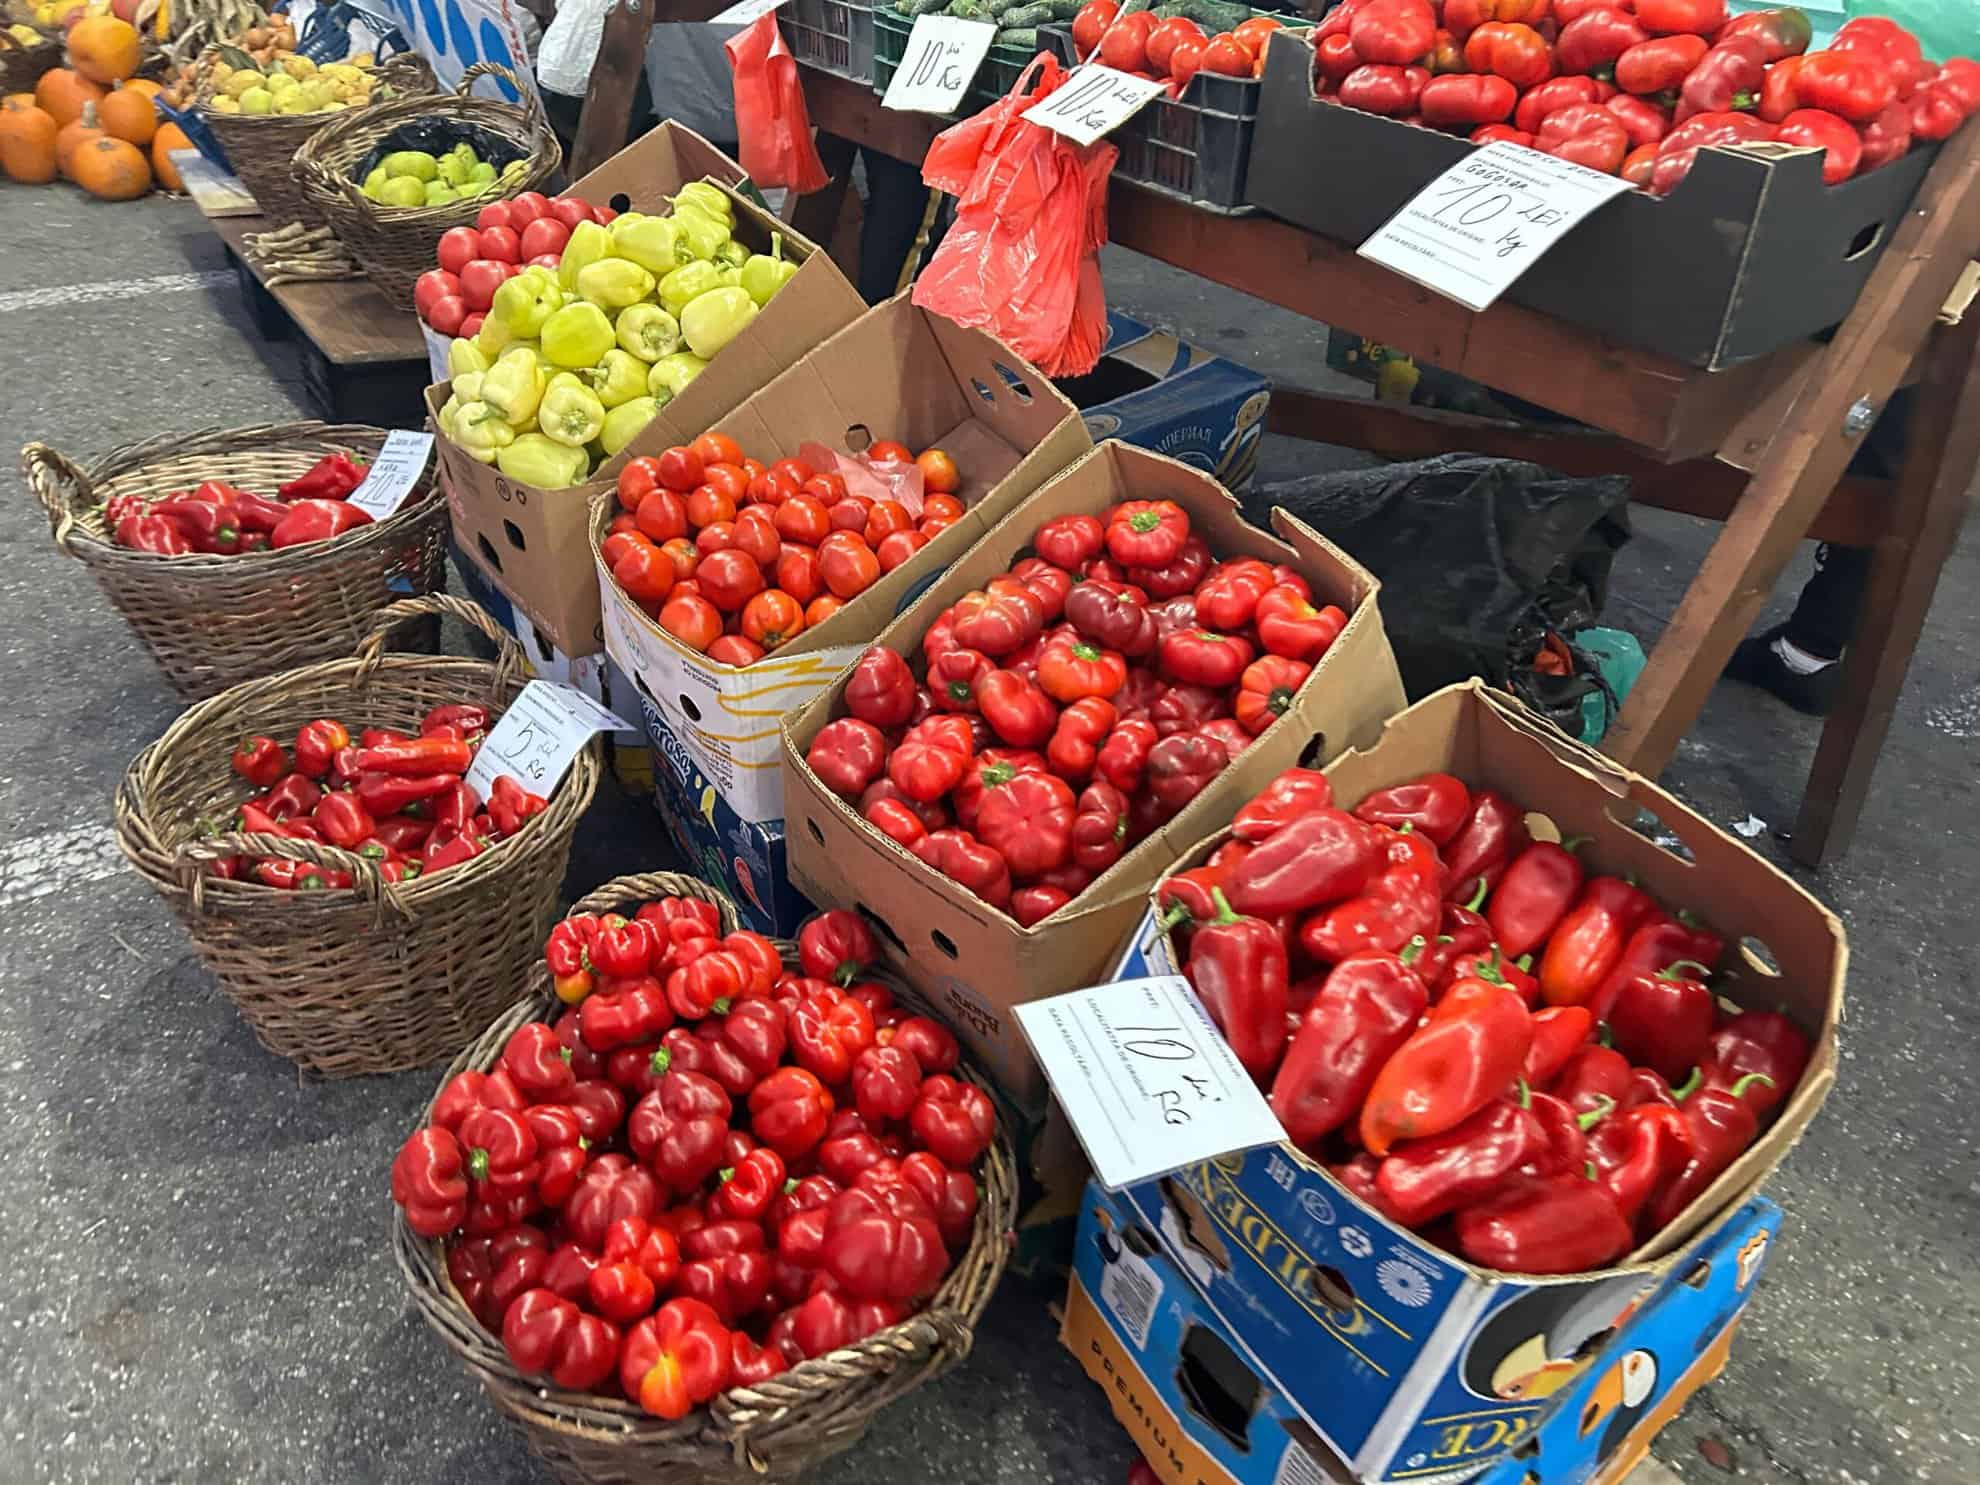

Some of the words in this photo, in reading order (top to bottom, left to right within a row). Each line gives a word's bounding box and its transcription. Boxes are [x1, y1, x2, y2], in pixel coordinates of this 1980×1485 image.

[905, 39, 945, 88] 10
[1045, 73, 1119, 116] 10
[1432, 182, 1512, 225] 10
[503, 720, 549, 759] 5
[1114, 1026, 1197, 1060] 10
[1091, 1337, 1184, 1474] PREMIUM
[1432, 1417, 1530, 1459] RCE
